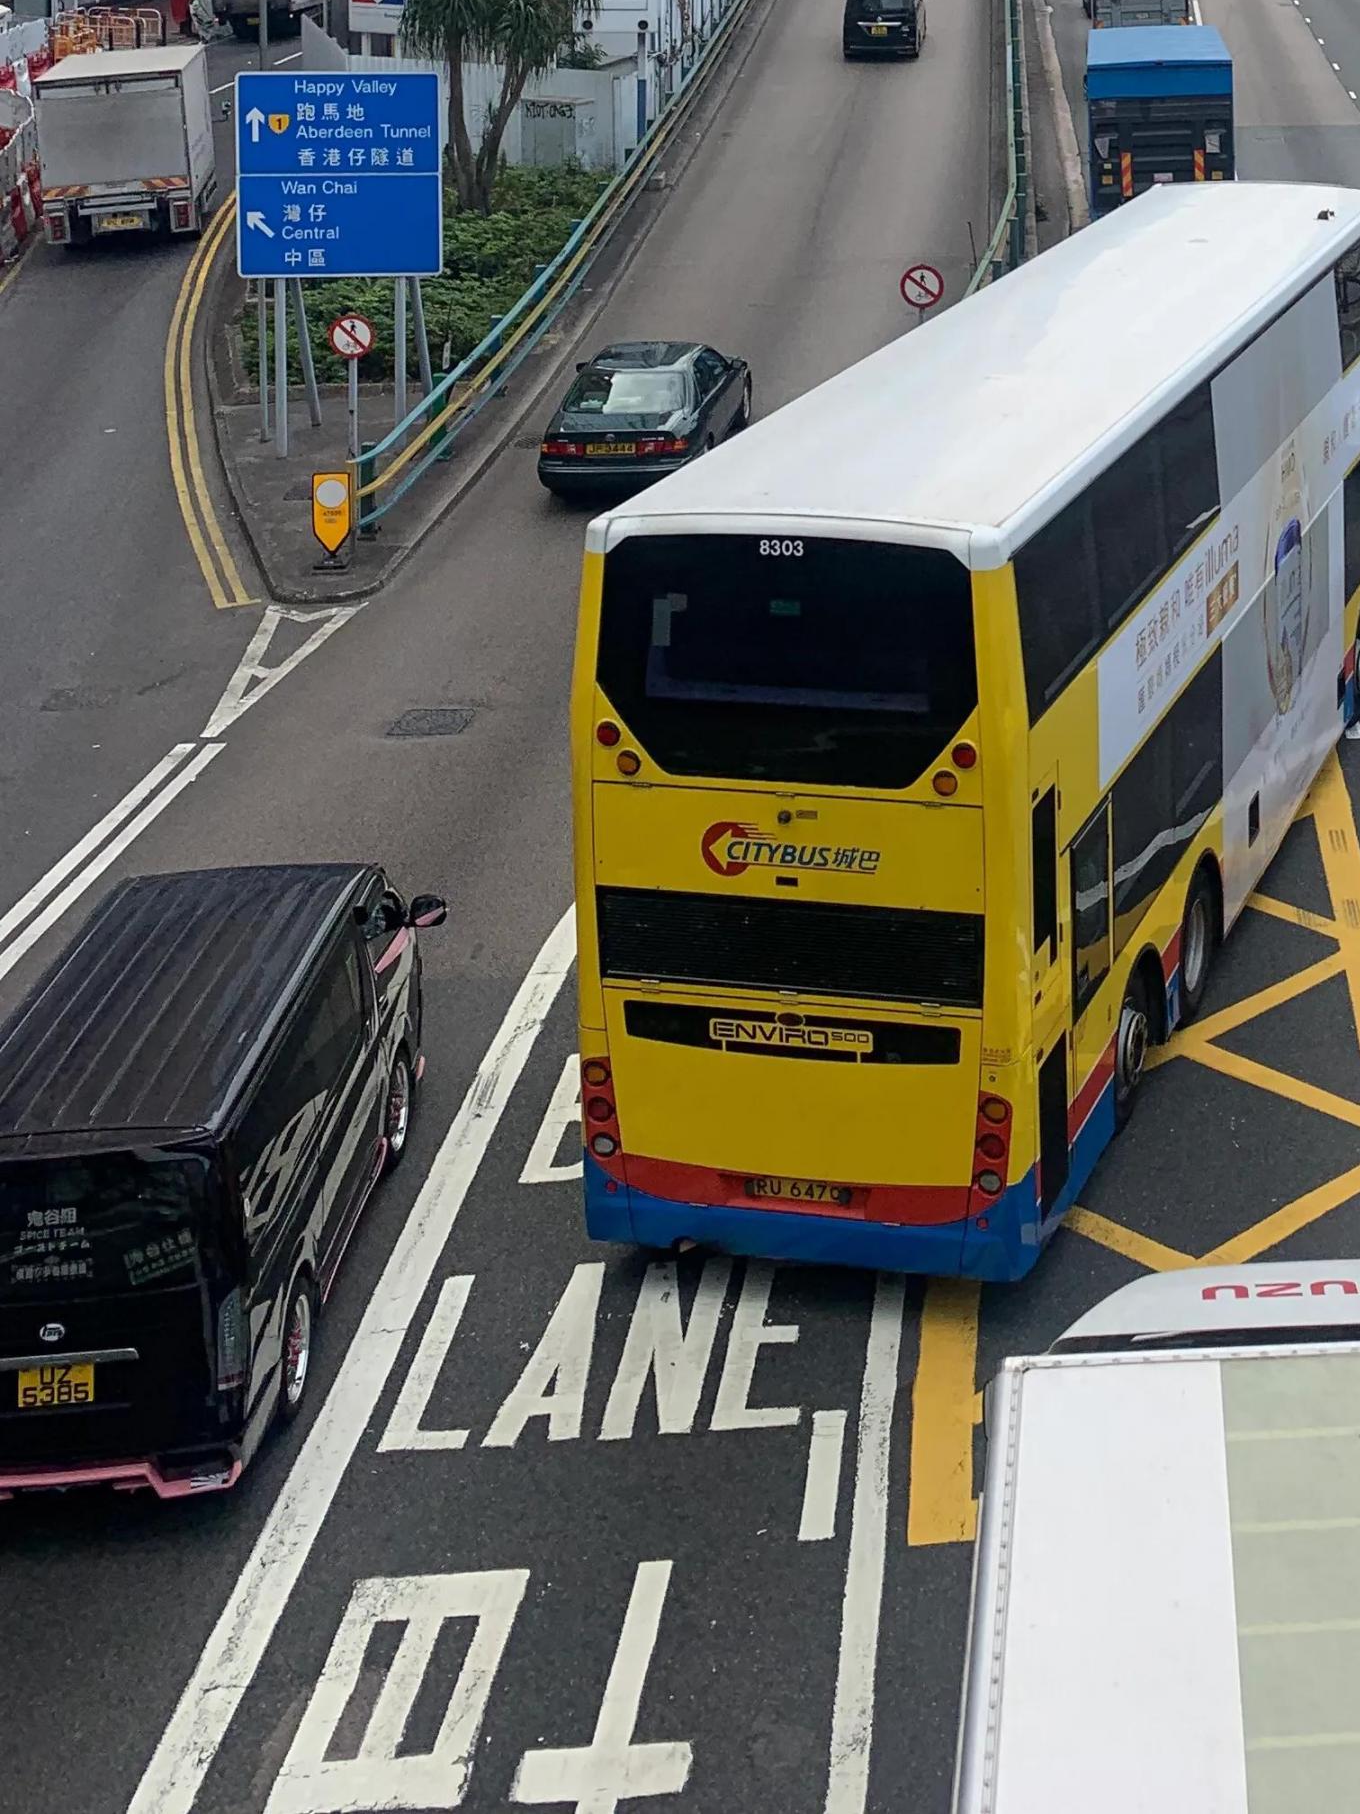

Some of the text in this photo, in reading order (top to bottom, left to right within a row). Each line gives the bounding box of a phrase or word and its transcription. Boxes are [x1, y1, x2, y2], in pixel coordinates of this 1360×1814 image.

[294, 79, 397, 97] Happy Valley
[296, 103, 365, 122] 跑馬地
[275, 118, 282, 131] 1
[296, 124, 432, 139] Aberdeen Tunnel
[298, 148, 414, 167] 香港仔隧道
[281, 180, 358, 195] Wan Chai
[283, 204, 327, 222] 灣仔
[281, 226, 339, 240] Central
[284, 248, 326, 267] 中區
[759, 539, 804, 557] 8303
[727, 841, 881, 870] CITYBUS 城巴
[757, 1179, 782, 1195] RU
[20, 1227, 85, 1241] SPICE TEAM
[376, 1261, 800, 1453] LANE
[41, 1365, 72, 1386] UZ
[23, 1382, 89, 1406] 5385
